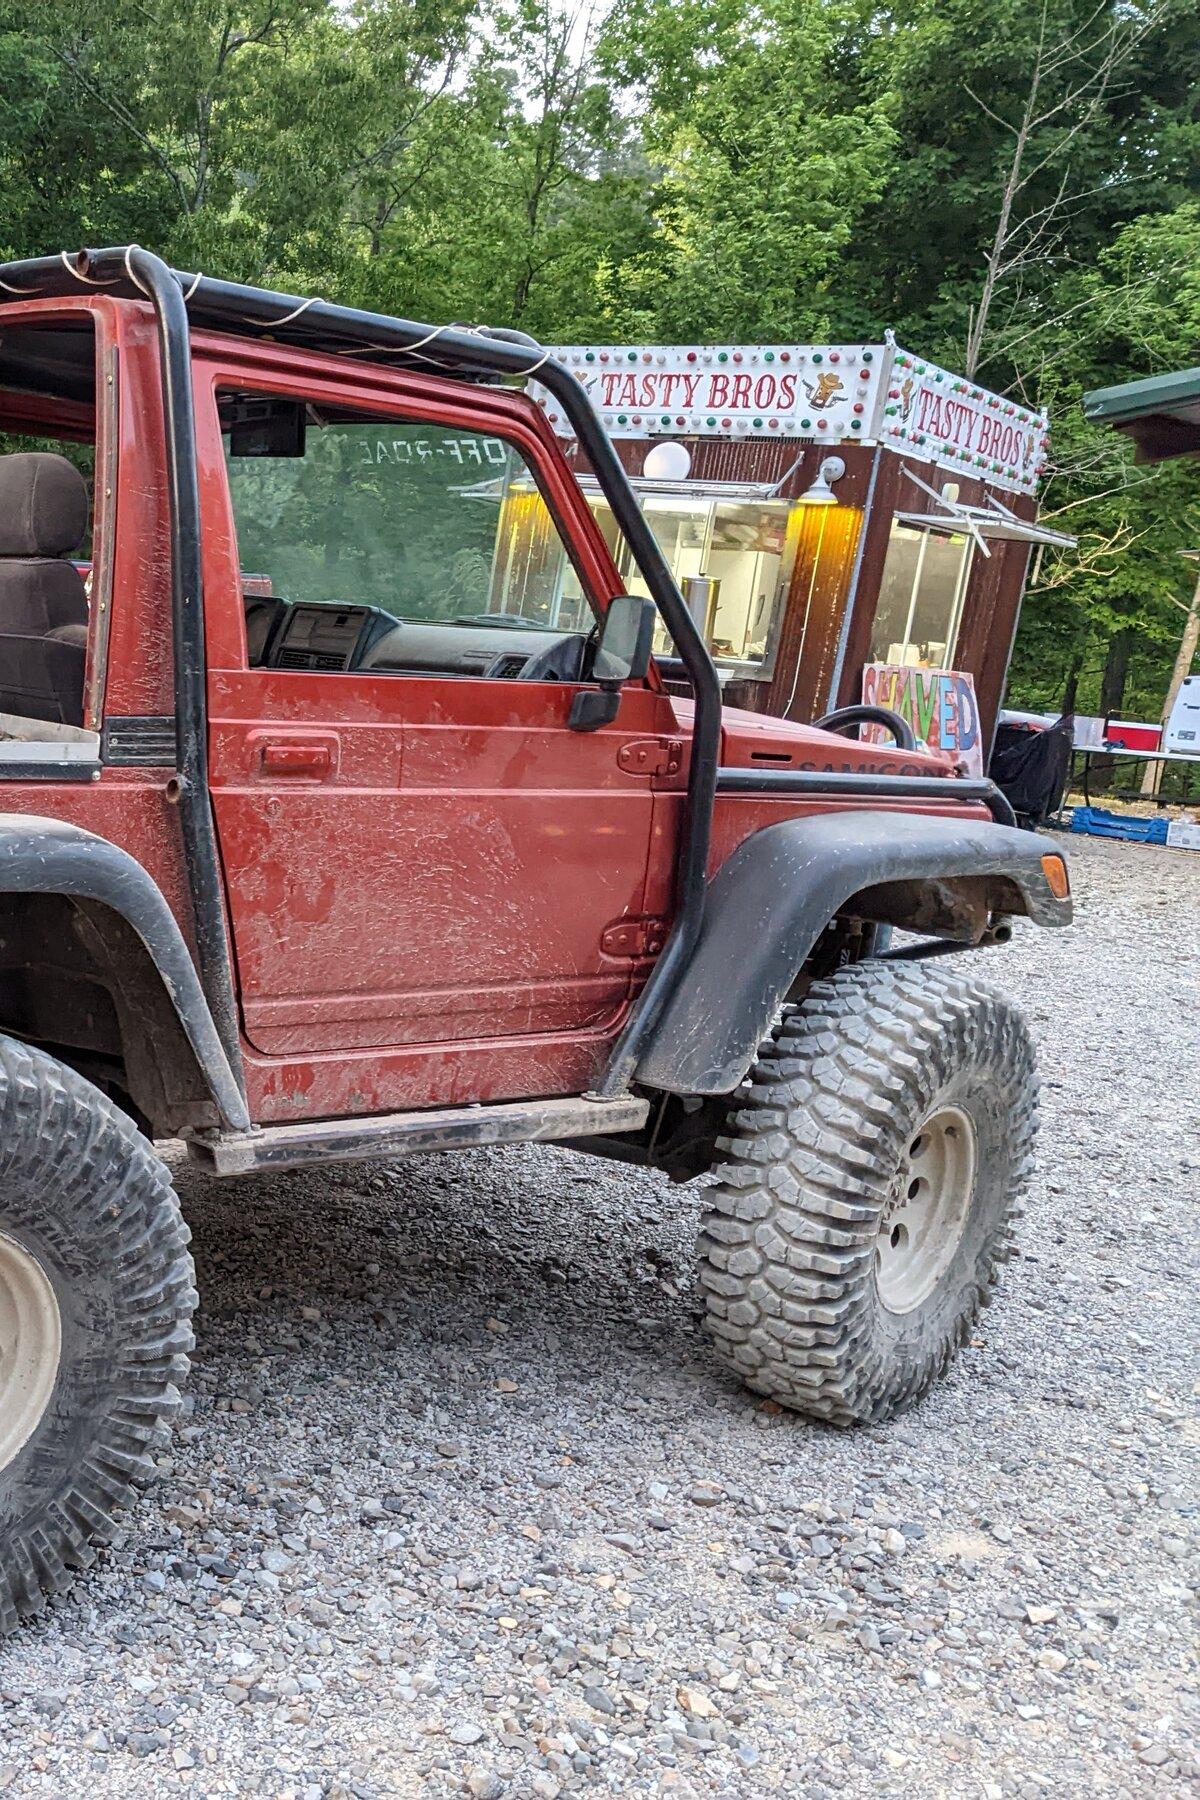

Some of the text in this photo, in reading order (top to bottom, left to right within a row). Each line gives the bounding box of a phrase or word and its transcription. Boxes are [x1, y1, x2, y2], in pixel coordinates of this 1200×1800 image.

[601, 373, 797, 409] TASTY BROS
[917, 387, 1023, 466] TASTY BROS
[861, 667, 977, 750] SHAVED
